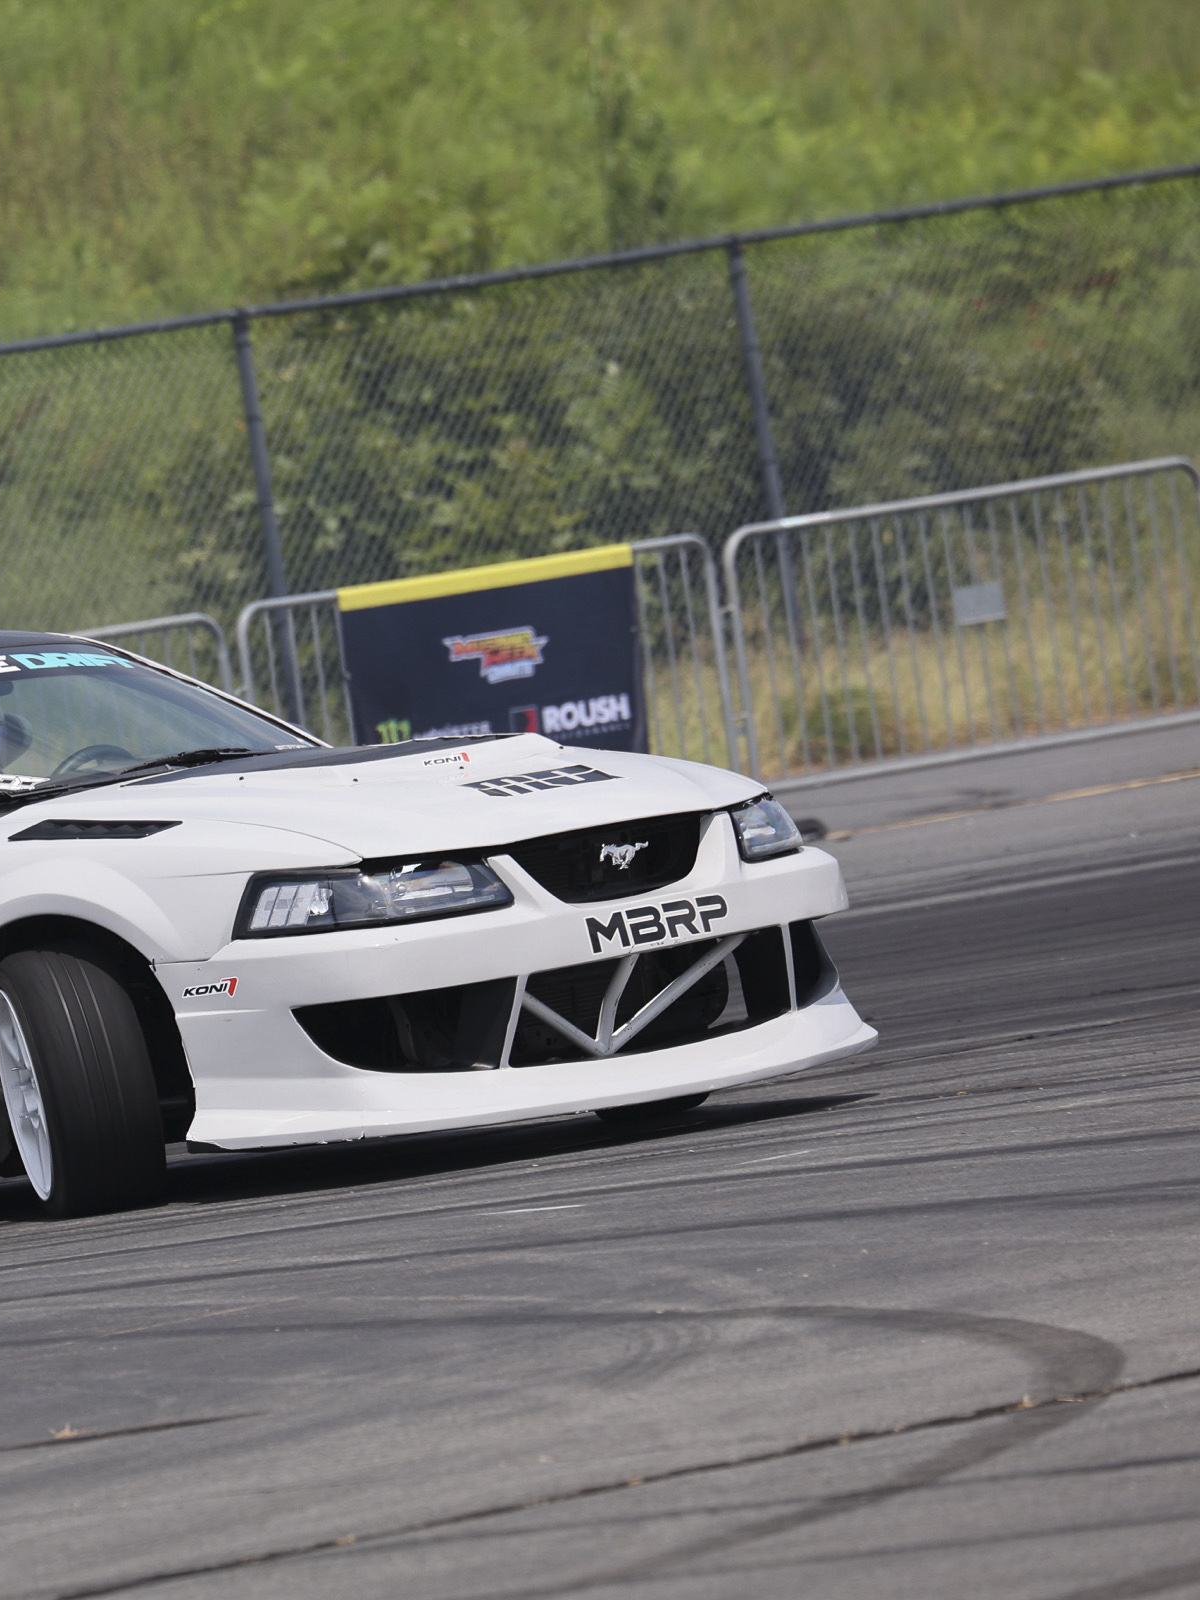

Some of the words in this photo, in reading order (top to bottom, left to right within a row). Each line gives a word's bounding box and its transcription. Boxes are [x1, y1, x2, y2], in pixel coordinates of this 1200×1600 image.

[9, 653, 134, 670] DRIFT
[542, 694, 631, 734] ROUSH
[424, 756, 461, 766] KONI
[585, 895, 728, 955] MBRP
[183, 982, 229, 997] KONI
